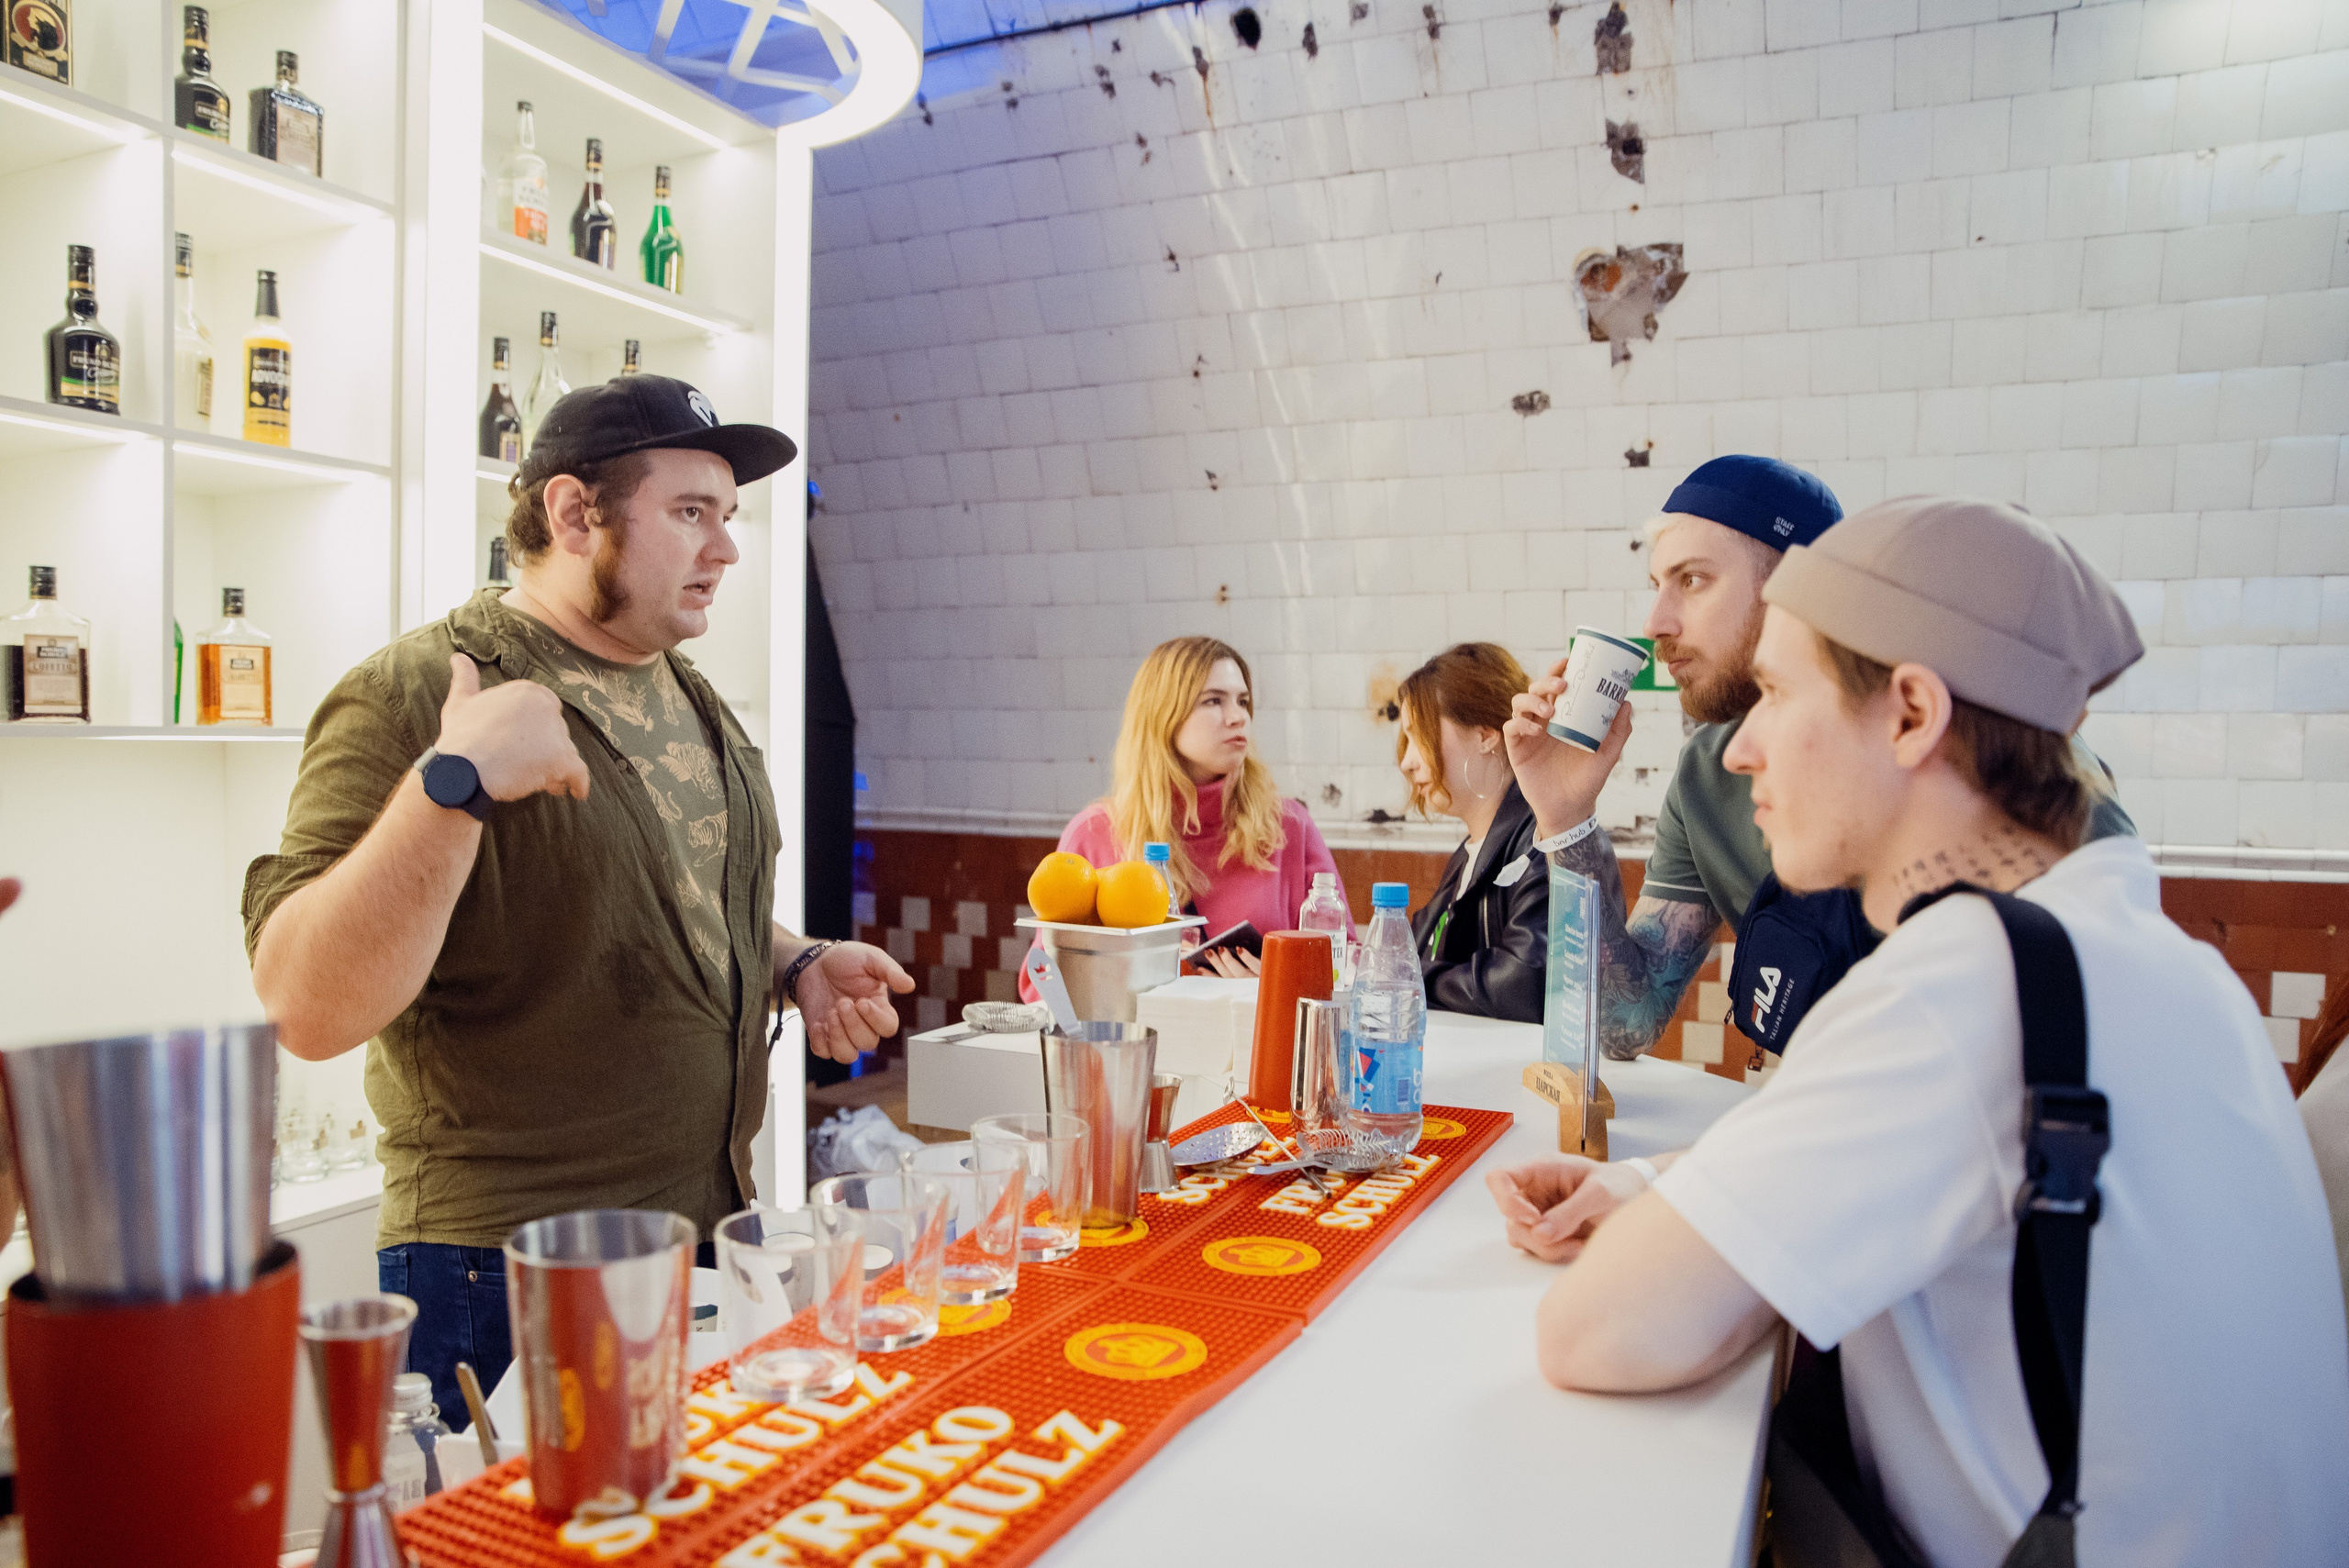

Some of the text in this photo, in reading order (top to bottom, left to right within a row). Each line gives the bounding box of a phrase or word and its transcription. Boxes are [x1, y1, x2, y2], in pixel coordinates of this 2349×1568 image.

[1751, 966, 1782, 1034] FILA
[1769, 977, 1796, 1041] TALIAN HERITAGE
[1535, 1075, 1561, 1103] ЦАРСКАЯ
[708, 1405, 1015, 1568] FRUKO
